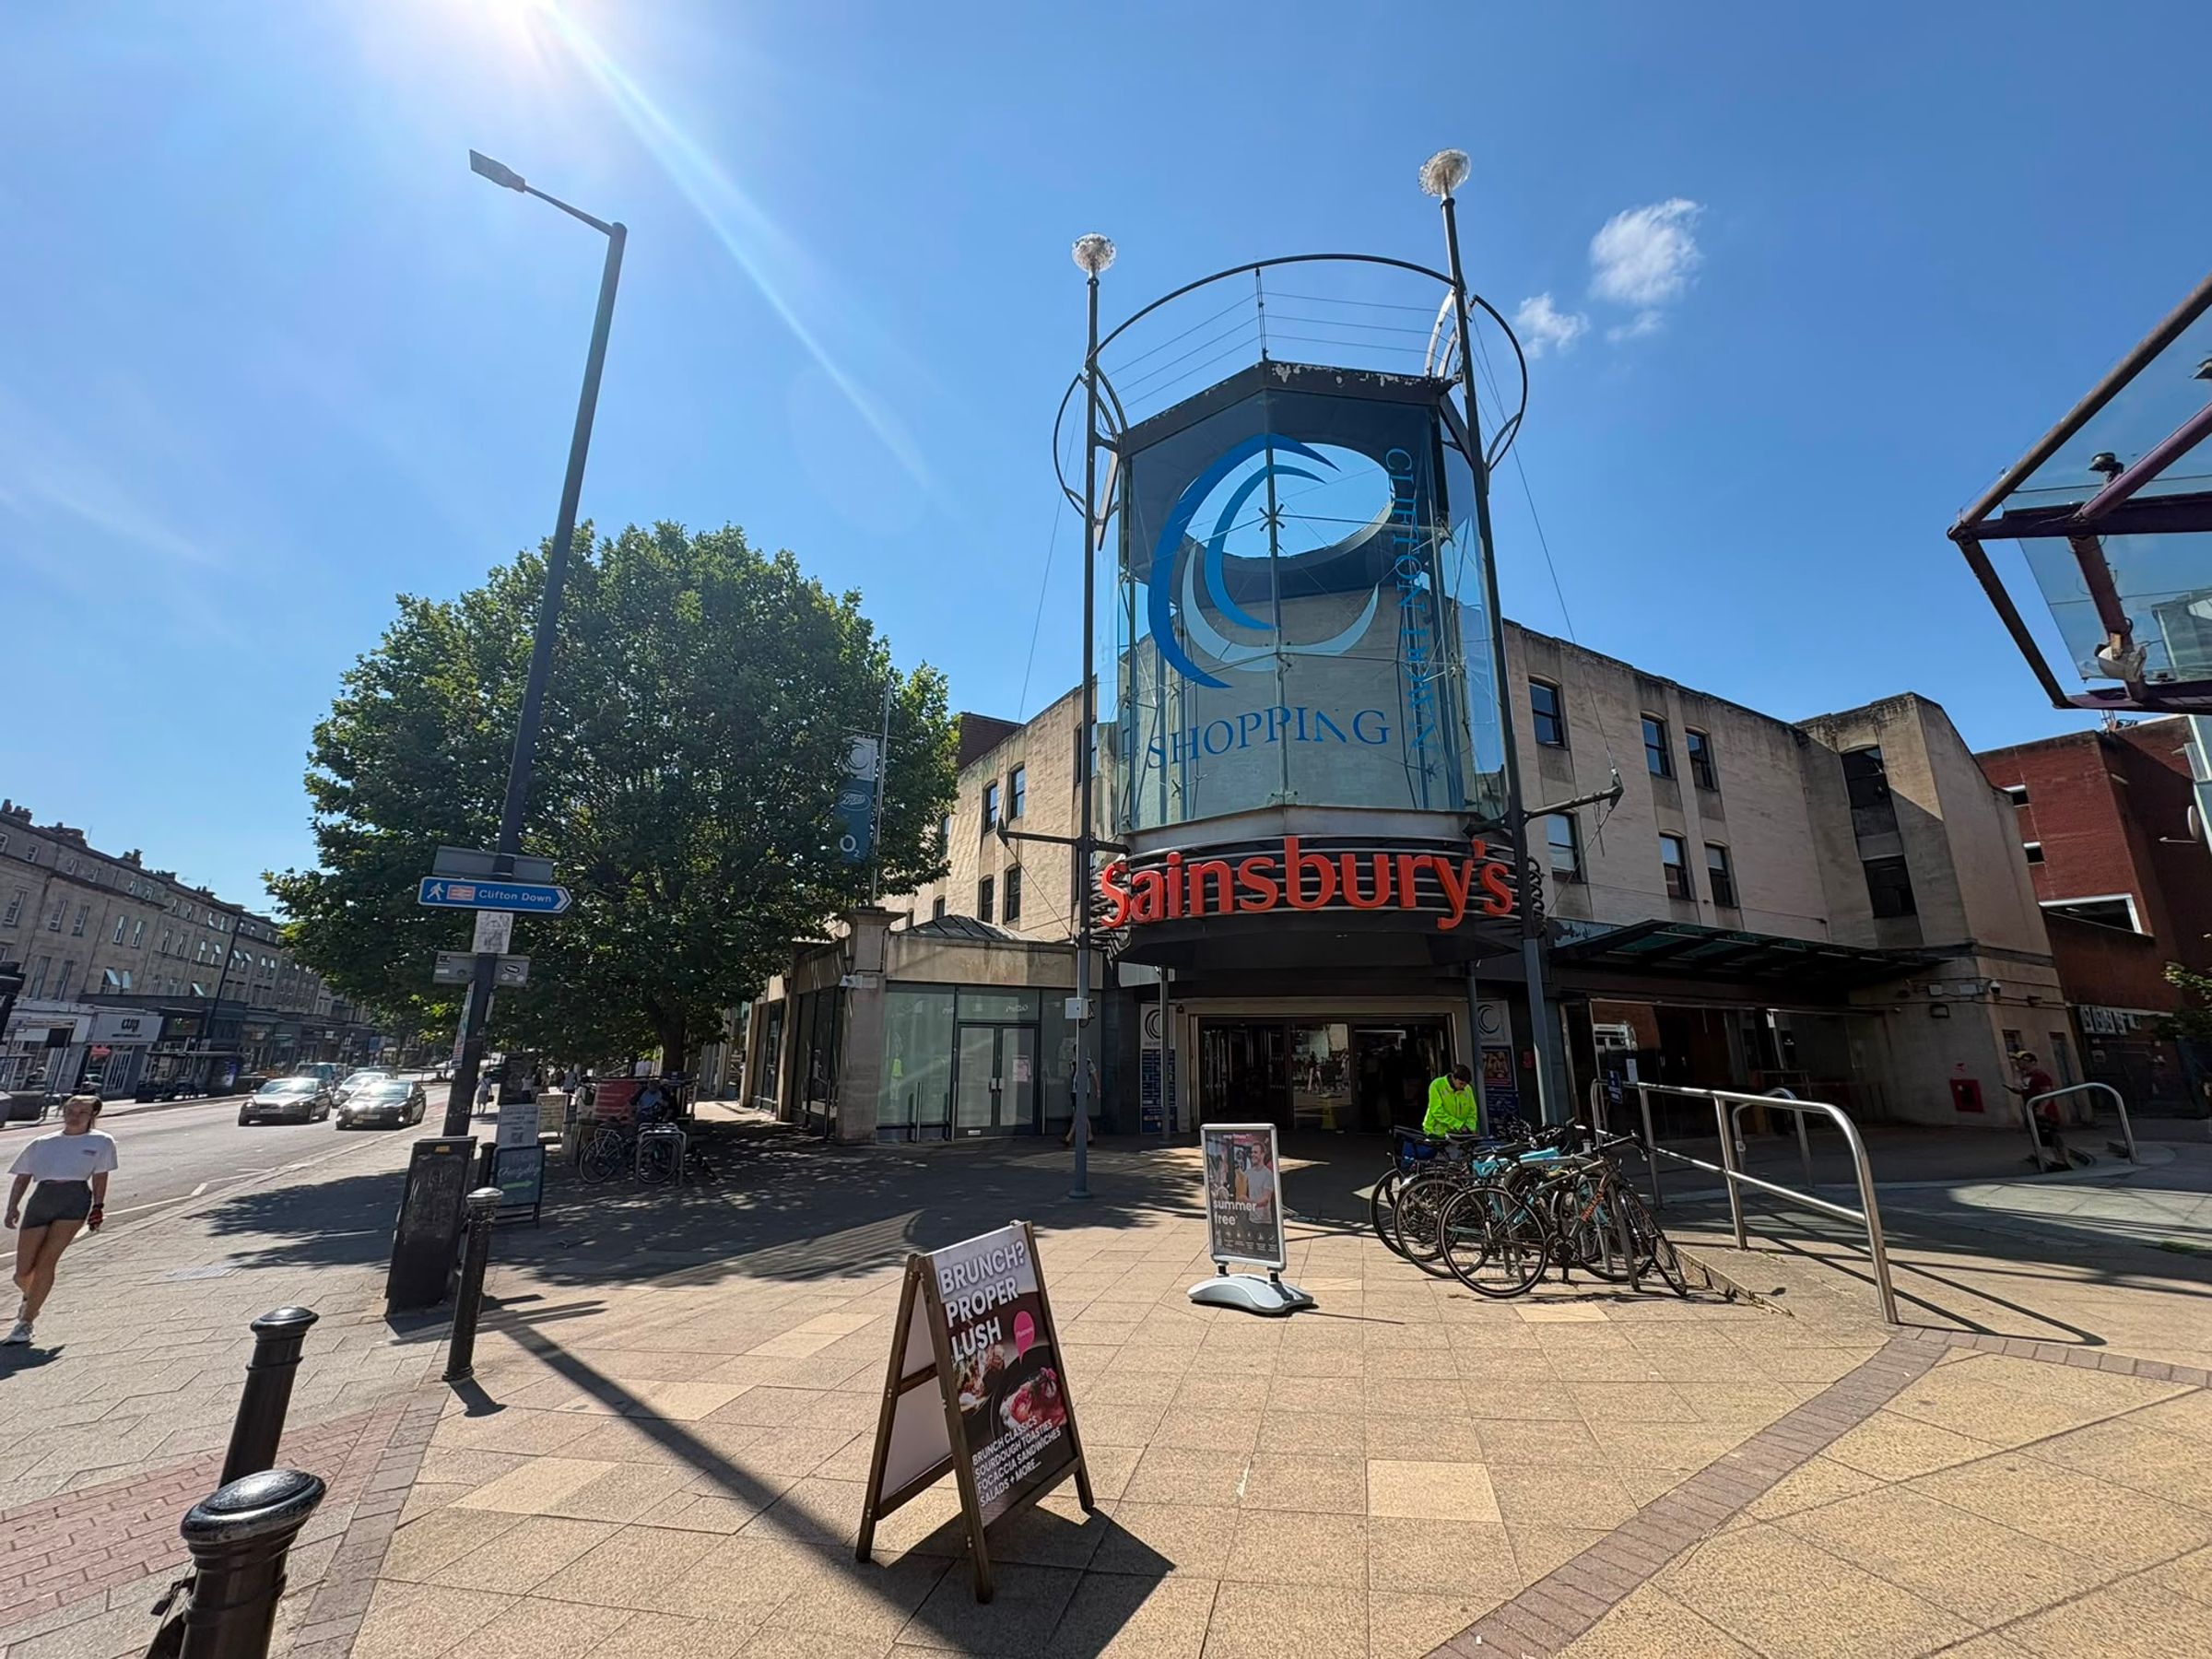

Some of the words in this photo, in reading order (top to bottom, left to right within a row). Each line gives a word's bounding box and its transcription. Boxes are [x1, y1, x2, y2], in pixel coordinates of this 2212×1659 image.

[1386, 448, 1428, 613] CLIFTON
[1147, 706, 1390, 771] SHOPPING
[478, 889, 518, 900] Clifton
[521, 891, 552, 902] Down
[1100, 836, 1513, 930] Sainsbury's
[1213, 1199, 1257, 1211] summer
[940, 1241, 1025, 1295] BRUNCH?
[945, 1277, 1018, 1328] PROPER
[951, 1316, 1002, 1362] LUSH
[971, 1437, 1005, 1465] BRUNCH
[1004, 1415, 1038, 1444] CLASSICS
[975, 1440, 1022, 1479] SOURDOUGH
[1021, 1418, 1053, 1447] TOASTIES
[977, 1458, 1018, 1493] FOCACCIA
[1017, 1426, 1062, 1465] SANDWICHES
[980, 1477, 1010, 1507] SALADS
